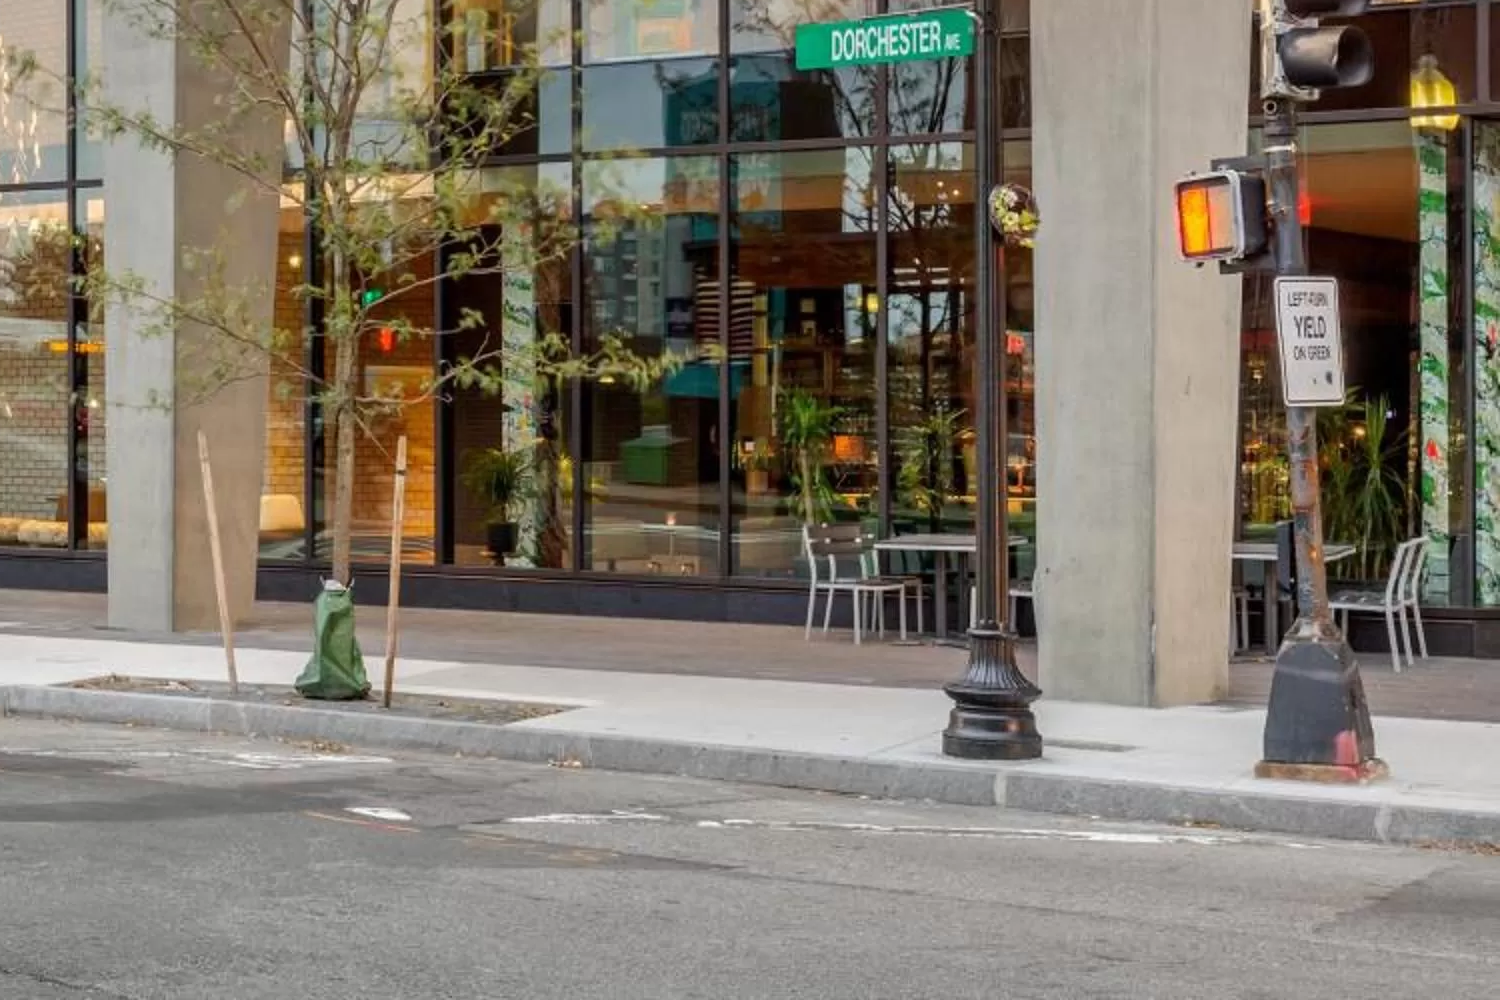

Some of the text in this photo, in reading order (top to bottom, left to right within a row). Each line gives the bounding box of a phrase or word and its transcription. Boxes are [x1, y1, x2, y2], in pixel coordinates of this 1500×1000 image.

[831, 20, 961, 61] DORCHESTER AVE
[1287, 291, 1307, 307] LEFT
[1293, 315, 1327, 339] YIELD
[1293, 345, 1331, 361] ON GREEN
